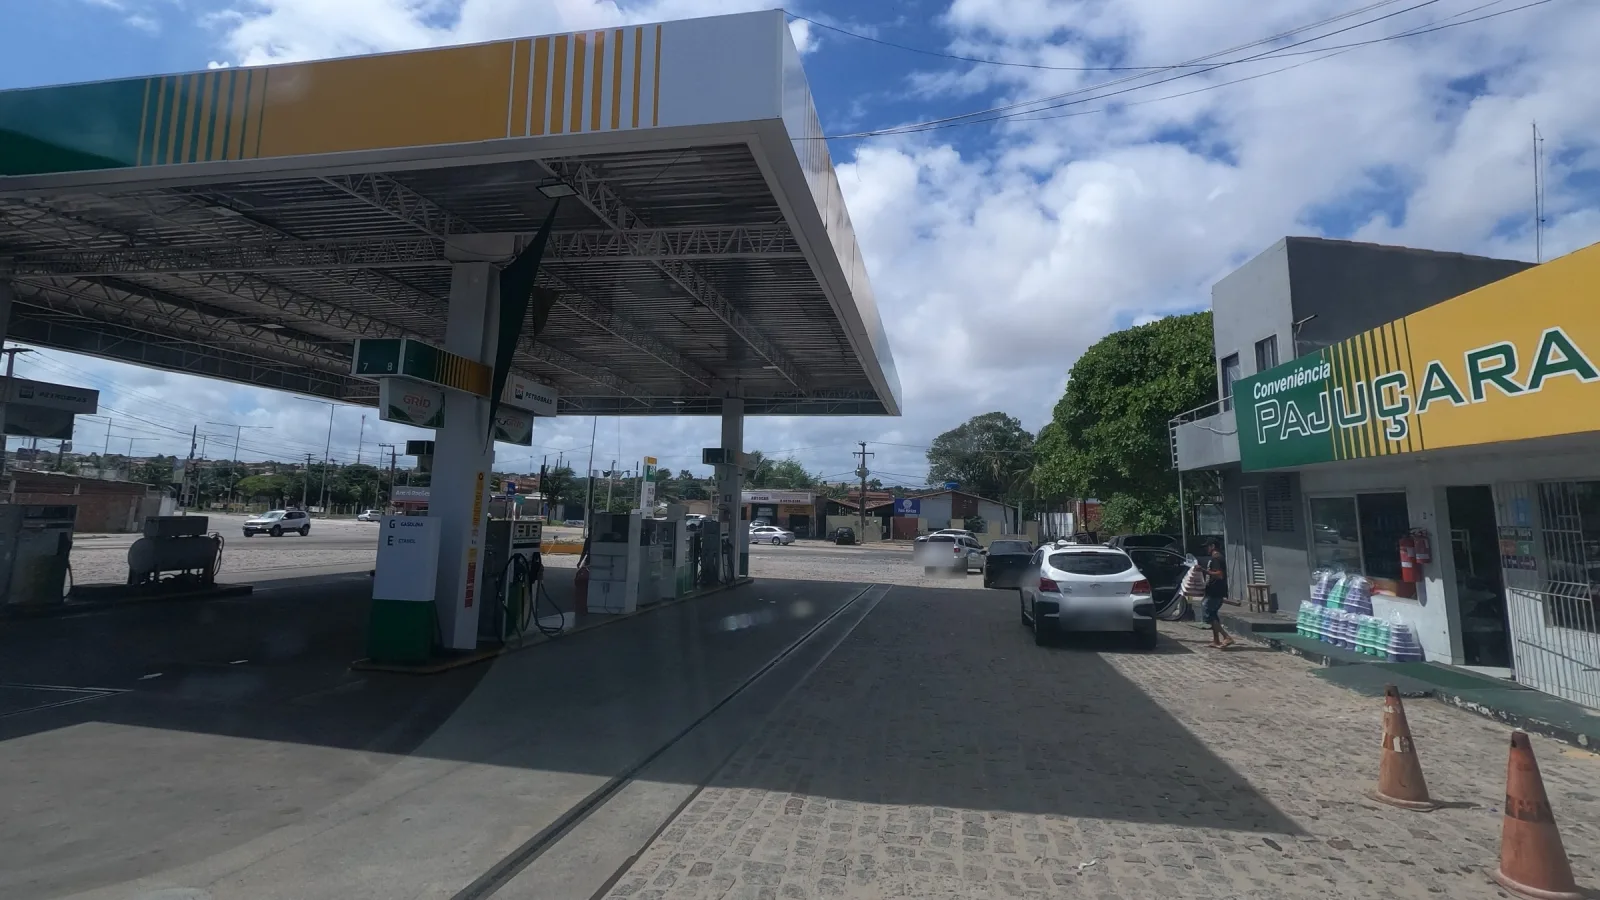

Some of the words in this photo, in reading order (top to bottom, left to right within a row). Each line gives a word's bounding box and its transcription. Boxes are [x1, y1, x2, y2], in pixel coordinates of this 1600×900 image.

[363, 362, 369, 371] 7
[386, 362, 393, 371] 8
[1253, 360, 1331, 400] Conveniência
[1254, 325, 1600, 444] PAJUÇARA
[403, 394, 431, 408] GRID
[525, 391, 553, 405] PETROBRAS
[389, 519, 396, 529] G
[387, 535, 394, 546] E
